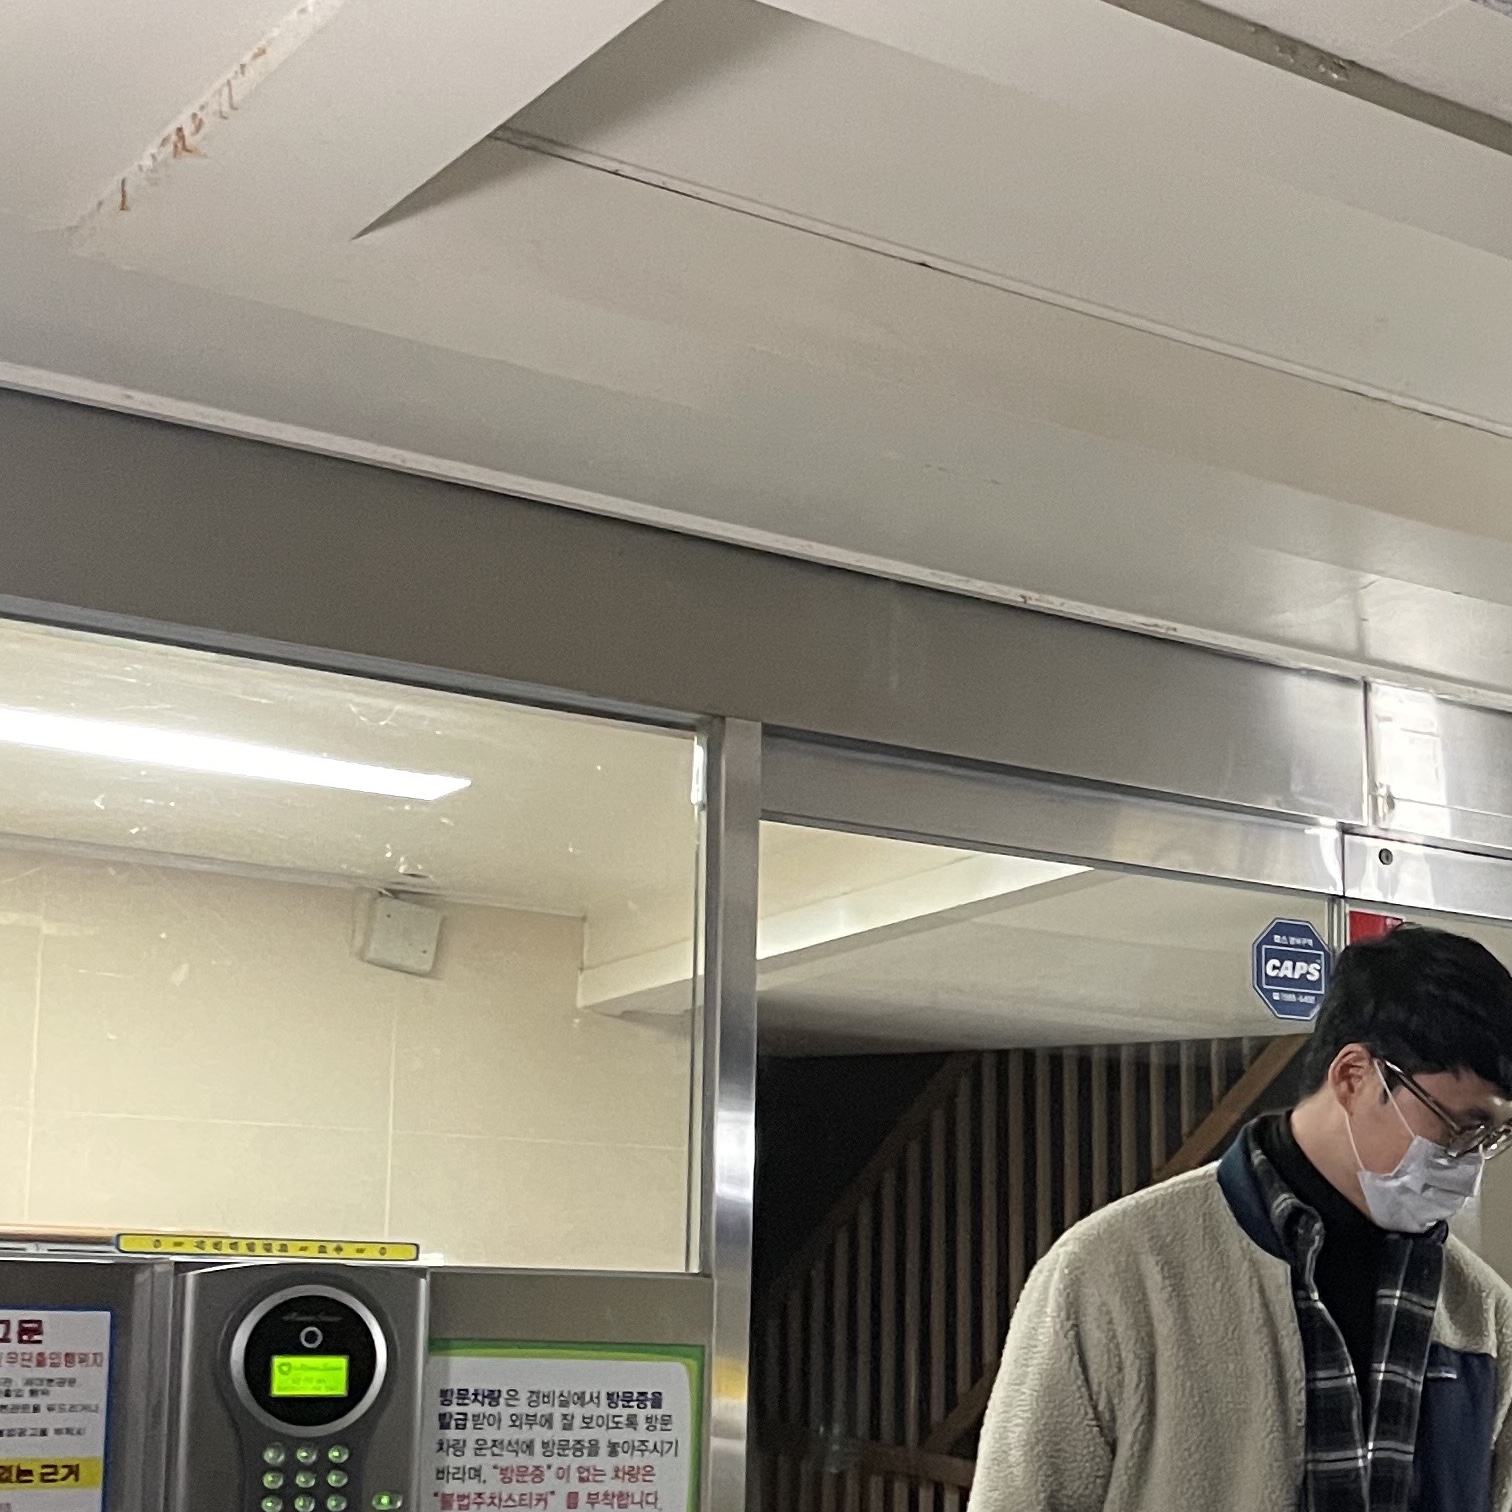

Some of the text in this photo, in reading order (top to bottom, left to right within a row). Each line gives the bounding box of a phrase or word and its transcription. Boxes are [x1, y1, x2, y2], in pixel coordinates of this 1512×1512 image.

[1266, 958, 1321, 981] CAPS
[527, 1390, 601, 1408] 경비실에서
[606, 1391, 663, 1410] 방문증을
[438, 1411, 468, 1431] 발급
[508, 1412, 554, 1431] 외부에
[561, 1413, 575, 1431] 잘
[580, 1413, 639, 1432] 보이도록
[645, 1414, 674, 1432] 방문
[436, 1438, 679, 1458] 차량 운전석에 방문증을 놓아주시기
[40, 1462, 80, 1483] 근거
[577, 1465, 607, 1484] 없는
[611, 1465, 656, 1483] 차량은
